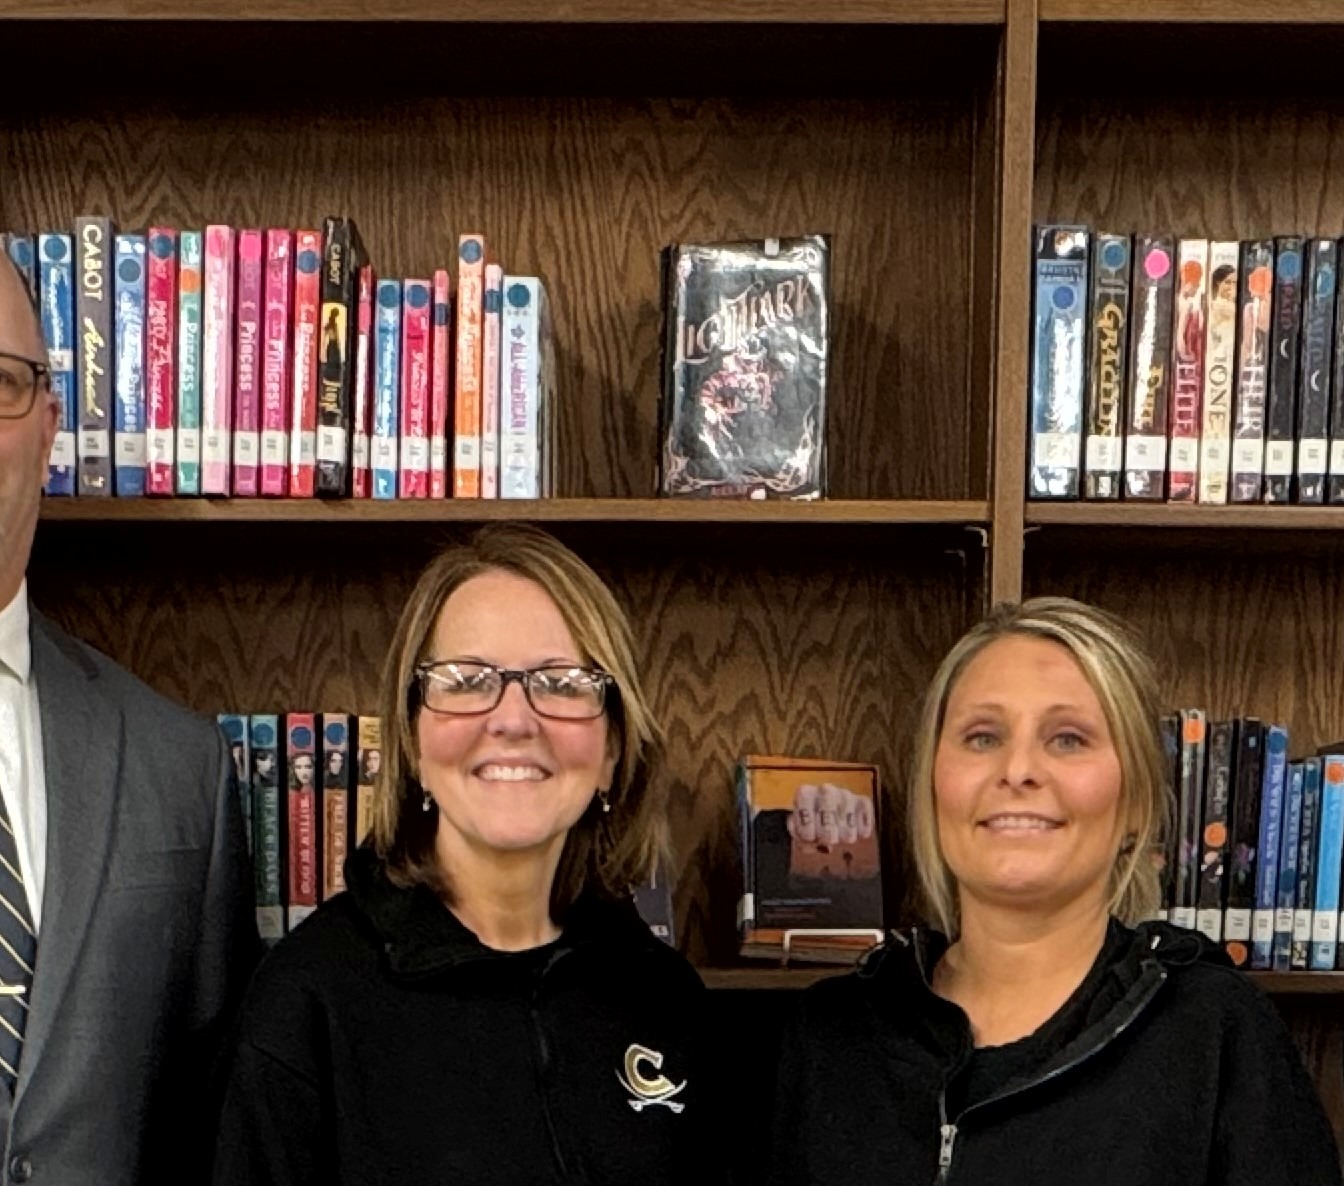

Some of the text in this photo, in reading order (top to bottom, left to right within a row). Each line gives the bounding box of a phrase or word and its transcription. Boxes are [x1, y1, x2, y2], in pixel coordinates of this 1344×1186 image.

[83, 224, 102, 300] CABOT
[240, 321, 257, 391] Princess
[123, 373, 138, 431] Princes
[1209, 365, 1227, 421] ONE
[625, 1043, 676, 1096] C
